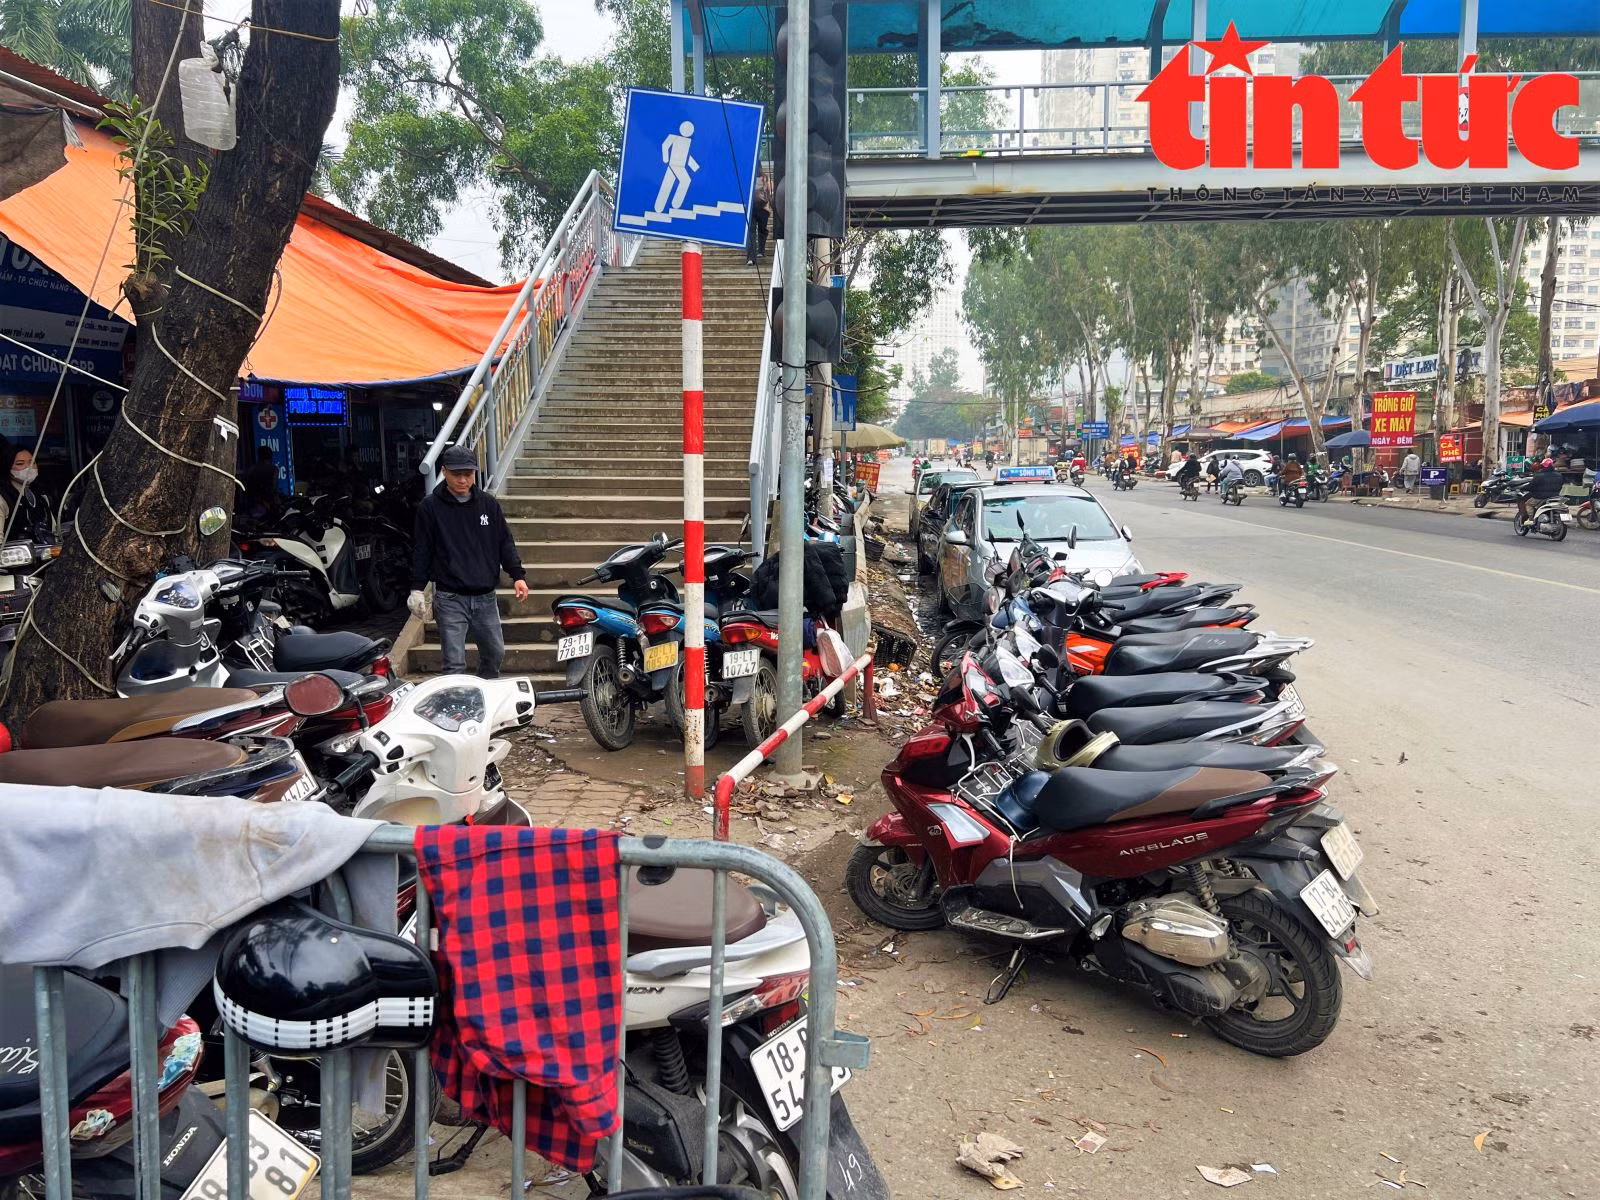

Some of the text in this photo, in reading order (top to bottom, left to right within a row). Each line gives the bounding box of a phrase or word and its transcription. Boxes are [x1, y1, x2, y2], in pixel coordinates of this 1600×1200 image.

[1374, 414, 1412, 433] XE MÁY
[562, 634, 588, 649] 29-T1
[559, 643, 591, 662] 778.99
[729, 651, 754, 664] 19-L1
[725, 661, 757, 679] 107.47
[1119, 832, 1209, 856] AIRBLADE
[1308, 876, 1339, 909] 17-B4
[1320, 895, 1354, 934] 542.05
[163, 1126, 198, 1167] HONDA
